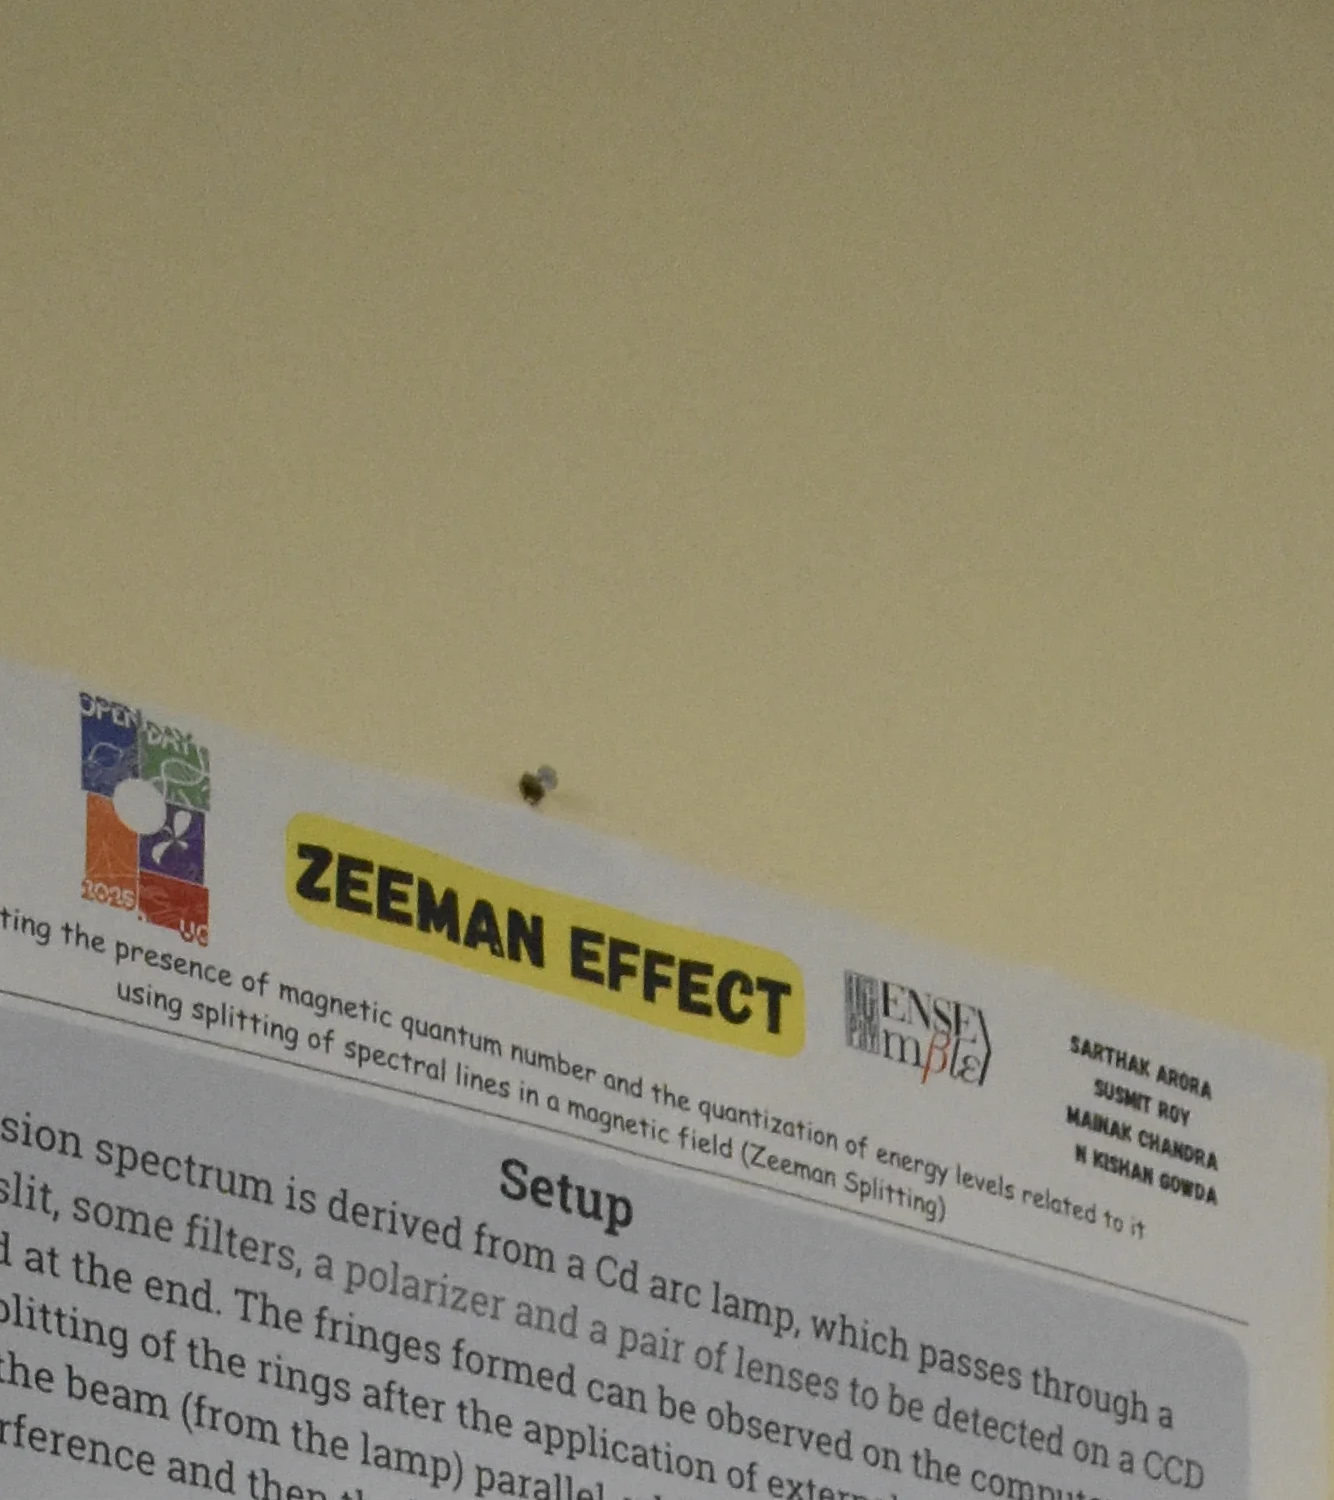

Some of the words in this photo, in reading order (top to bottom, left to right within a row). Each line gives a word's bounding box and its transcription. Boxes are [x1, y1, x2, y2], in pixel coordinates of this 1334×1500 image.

[296, 843, 544, 968] ZEEMAN
[571, 926, 791, 1035] EFFECT
[61, 921, 106, 954] the
[114, 940, 233, 987] presence
[241, 971, 270, 997] of
[279, 982, 392, 1028] magnetic
[400, 1015, 503, 1058] quantum
[511, 1043, 597, 1083] number
[603, 1073, 643, 1098] and
[651, 1083, 691, 1113] the
[698, 1100, 838, 1152] quantization
[845, 1135, 868, 1160] of
[876, 1148, 949, 1187] energy
[956, 1162, 1015, 1201] levels
[1021, 1188, 1097, 1224] related
[1103, 1210, 1123, 1234] to
[1131, 1216, 1146, 1240] it
[116, 981, 183, 1021] using
[191, 1001, 299, 1051] splitting
[307, 1028, 335, 1054] of
[344, 1040, 447, 1083] spectral
[455, 1062, 510, 1100] lines
[519, 1080, 539, 1107] in
[547, 1094, 560, 1113] a
[567, 1099, 670, 1144] magnetic
[677, 1126, 733, 1159] field
[741, 1140, 836, 1188] (Zeeman
[844, 1170, 946, 1223] Splitting)
[1069, 1035, 1151, 1077] SARTHAK
[1156, 1065, 1212, 1100] ARORA
[1094, 1078, 1152, 1113] SUSMIT
[1157, 1101, 1191, 1127] ROY
[1066, 1105, 1132, 1142] MAINAK
[1138, 1129, 1218, 1171] CHANDRA
[1074, 1143, 1087, 1164] N
[1092, 1148, 1155, 1186] KISHAN
[1159, 1172, 1218, 1206] GOWDA
[500, 1158, 634, 1235] Setup
[95, 1139, 275, 1206] spectrum
[285, 1175, 316, 1215] is
[327, 1187, 463, 1251] derived
[473, 1221, 556, 1273] from
[567, 1254, 585, 1282] a
[595, 1255, 639, 1295] Cd
[649, 1274, 701, 1309] arc
[711, 1280, 800, 1339] lamp,
[810, 1312, 909, 1362] which
[917, 1342, 1022, 1390] passes
[1031, 1366, 1149, 1426] through
[1158, 1406, 1174, 1430] a
[23, 1246, 61, 1278] at
[71, 1250, 133, 1295] the
[144, 1276, 222, 1317] end.
[234, 1286, 303, 1334] The
[314, 1305, 441, 1366] fringes
[451, 1337, 577, 1398] formed
[587, 1378, 648, 1414] can
[657, 1384, 696, 1425] be
[706, 1400, 853, 1462] observed
[862, 1444, 903, 1474] on
[910, 1447, 961, 1487] the
[167, 1457, 236, 1496] and
